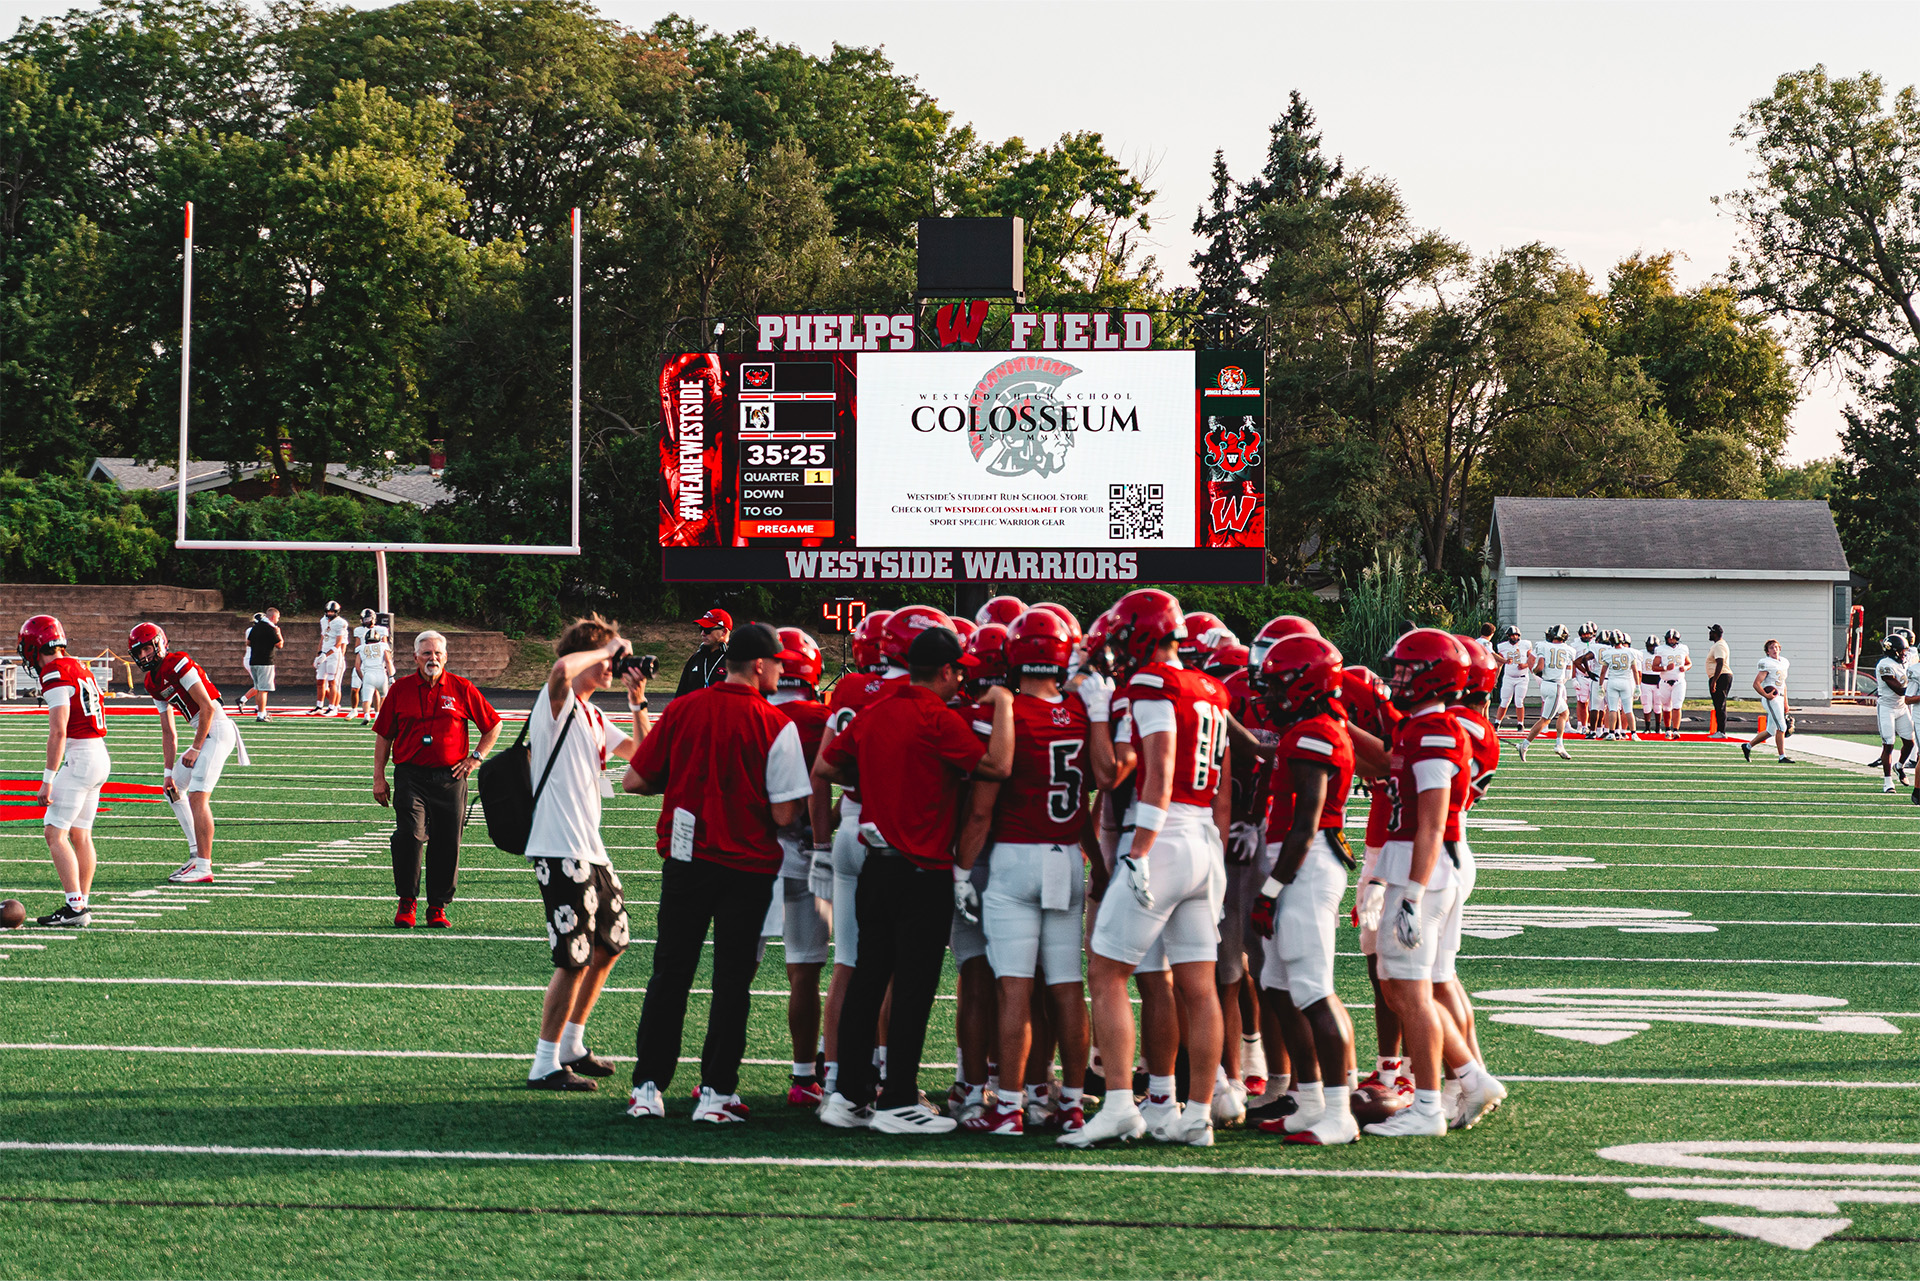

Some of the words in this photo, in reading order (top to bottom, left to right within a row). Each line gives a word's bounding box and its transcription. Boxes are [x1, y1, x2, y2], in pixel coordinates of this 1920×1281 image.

[757, 314, 916, 351] PHELPS
[1011, 313, 1152, 350] FIELD
[911, 405, 1141, 432] COLOSSEUM
[679, 379, 704, 521] #WEAREWESTSIDE
[747, 444, 826, 466] 35:25
[744, 472, 799, 483] QUARTER
[813, 471, 824, 484] 1
[743, 489, 784, 499] DOWN
[957, 493, 998, 501] STUDENT
[1000, 493, 1020, 501] RUN
[1021, 493, 1058, 501] SCHOOL
[1060, 493, 1089, 501] STORE
[743, 506, 761, 516] TO
[763, 506, 783, 516] GO
[891, 505, 922, 514] CHECK
[923, 506, 942, 514] OUT
[1059, 506, 1078, 514] FOR
[1079, 506, 1104, 514] YOUR
[757, 525, 815, 534] PREGAME
[929, 518, 958, 526] SPORT
[959, 518, 997, 526] SPECIFIC
[999, 518, 1041, 526] WARRIOR
[1042, 518, 1066, 526] GEAR
[786, 551, 954, 579] WESTSIDE
[961, 551, 1138, 579] WARRIORS
[822, 601, 867, 633] 40
[1548, 648, 1567, 669] 16
[1611, 653, 1629, 670] 59
[1022, 664, 1060, 674] Riddell
[1047, 739, 1084, 823] 5
